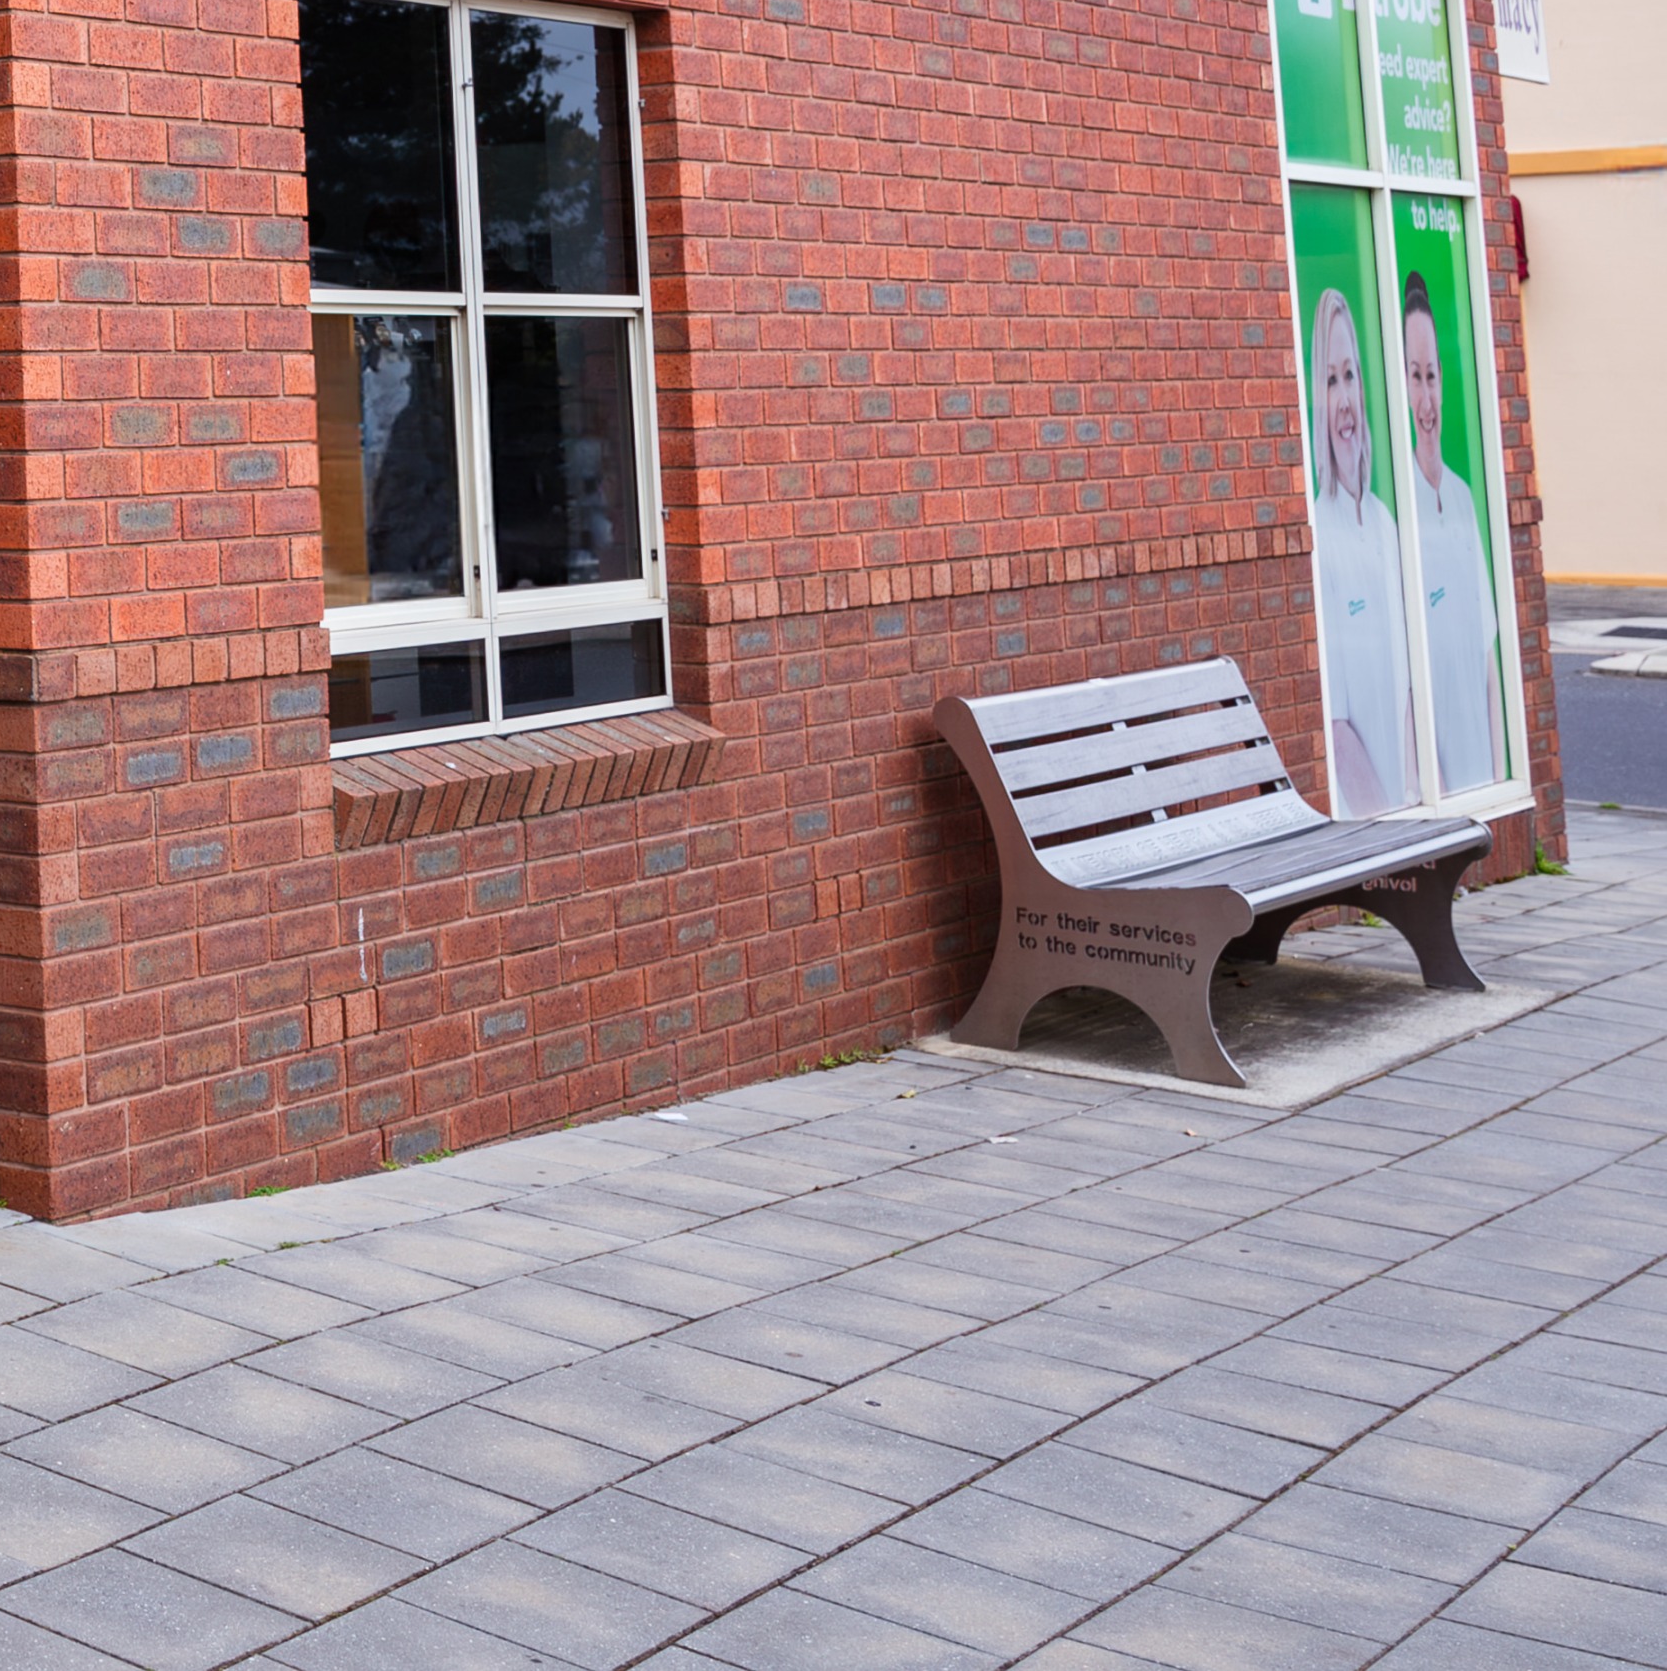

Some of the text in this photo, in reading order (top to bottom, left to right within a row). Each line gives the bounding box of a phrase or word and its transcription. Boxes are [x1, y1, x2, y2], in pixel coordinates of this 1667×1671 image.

[1380, 44, 1448, 91] eed expert
[1404, 95, 1451, 132] advice?
[1387, 143, 1457, 180] We're here
[1411, 197, 1460, 241] to help.
[1016, 906, 1197, 946] For their services
[1018, 932, 1196, 976] to the community
